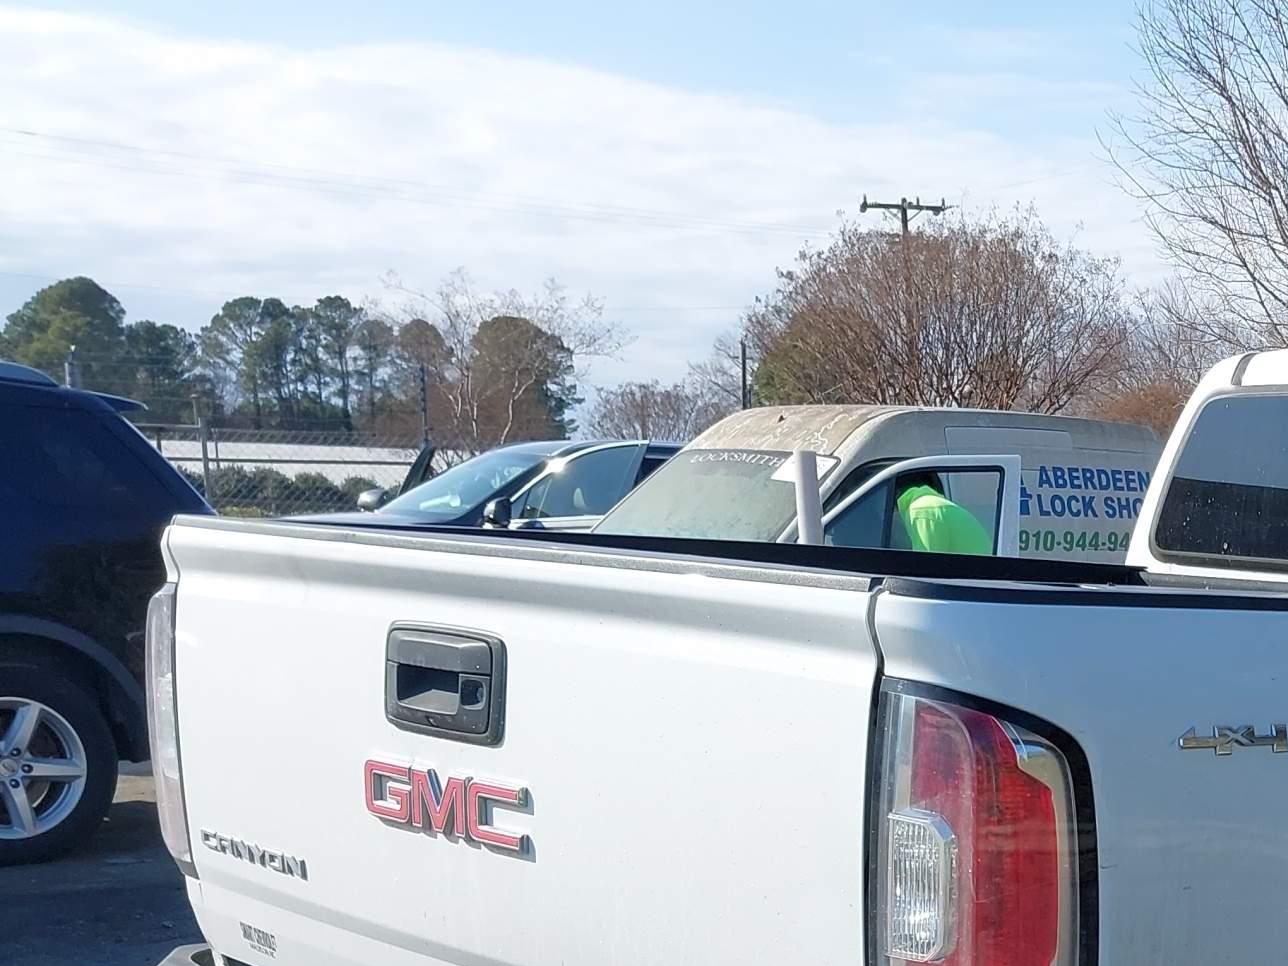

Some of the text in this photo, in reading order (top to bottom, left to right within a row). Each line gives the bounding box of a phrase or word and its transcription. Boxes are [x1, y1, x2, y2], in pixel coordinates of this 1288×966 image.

[690, 451, 785, 467] LOCKSMITH
[1038, 466, 1151, 492] ABERDEEN
[1037, 493, 1099, 518] LOCK
[364, 758, 532, 852] GMC
[200, 829, 308, 881] CANYON
